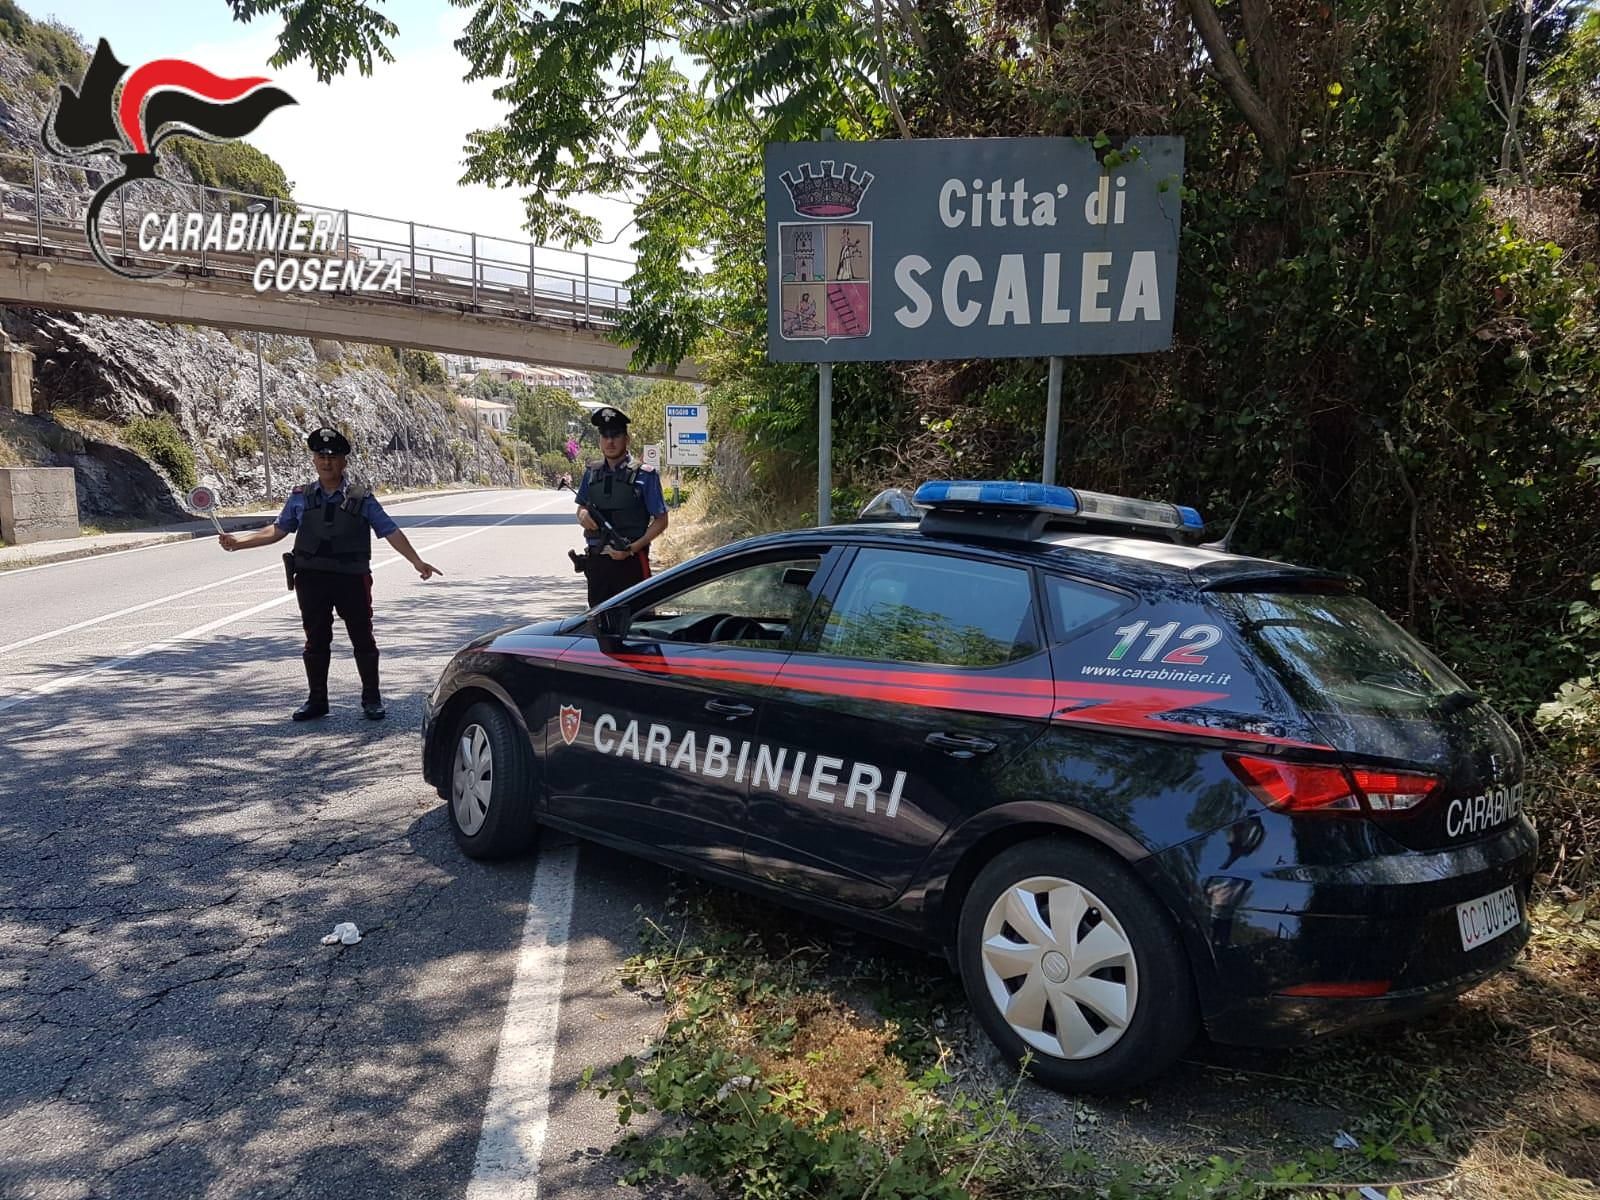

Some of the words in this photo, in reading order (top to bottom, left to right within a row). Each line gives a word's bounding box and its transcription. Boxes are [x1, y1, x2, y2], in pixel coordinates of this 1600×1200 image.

[938, 178, 1068, 229] Citta'
[1084, 176, 1127, 225] di
[894, 251, 1161, 329] SCALEA
[1107, 620, 1223, 665] 112
[1081, 664, 1232, 686] www.carabinieri.it
[593, 713, 907, 818] CARABINIERI
